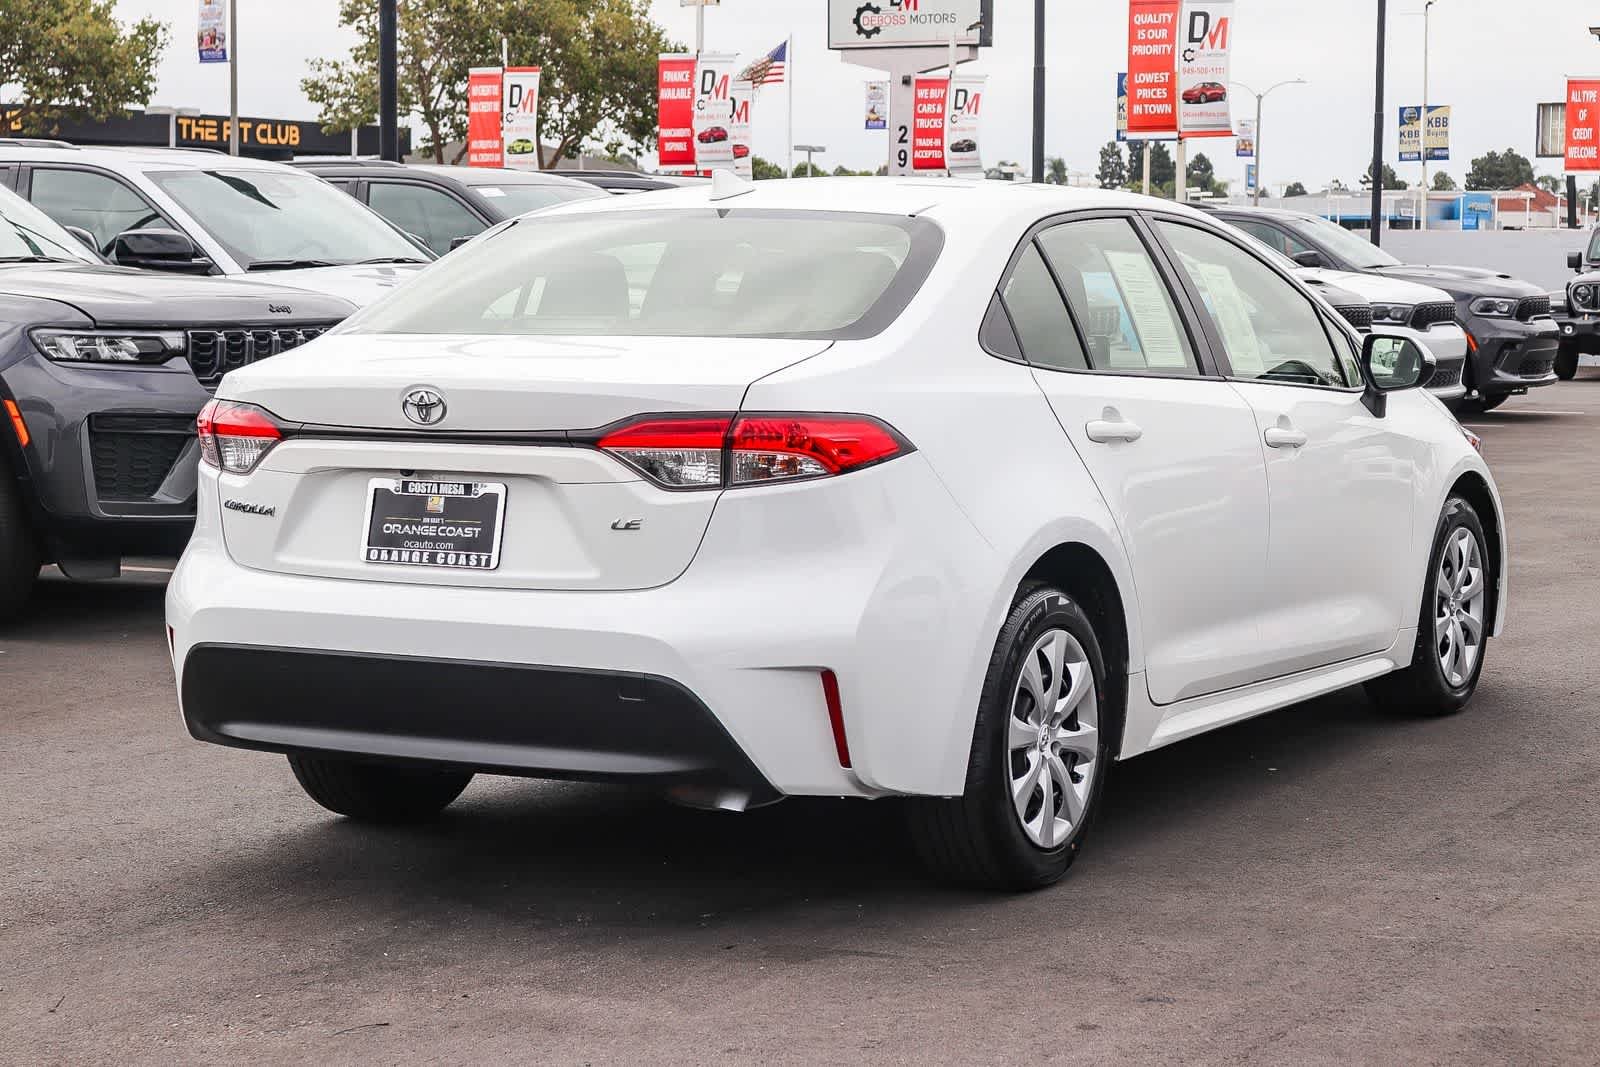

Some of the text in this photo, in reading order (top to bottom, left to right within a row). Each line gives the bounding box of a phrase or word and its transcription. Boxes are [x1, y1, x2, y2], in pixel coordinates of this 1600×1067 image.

[862, 13, 957, 26] DEBOSS MOTORS
[1133, 13, 1173, 25] QUALITY
[1138, 29, 1168, 39] IS OUR
[1188, 11, 1229, 50] DM
[1132, 44, 1173, 56] PRIORITY
[1134, 73, 1170, 83] LOWEST
[702, 70, 729, 100] DM
[509, 84, 534, 113] DM
[660, 88, 692, 99] AVAILABLE
[917, 89, 945, 98] WE BUY
[1136, 88, 1167, 99] PRICES
[1571, 91, 1597, 102] ALL TYPE
[954, 88, 981, 115] DM
[917, 104, 936, 113] CARS
[1133, 104, 1144, 114] IN
[1144, 104, 1172, 114] TOWN
[1579, 109, 1587, 120] OF
[916, 119, 942, 128] TRUCKS
[1427, 117, 1448, 128] KBB
[178, 118, 299, 145] THE FT CLUB
[1573, 128, 1593, 139] CREDIT
[1568, 147, 1597, 158] WELCOME
[408, 482, 464, 495] COSTA MESA
[224, 500, 275, 517] COROLLA
[611, 519, 643, 530] LE
[403, 539, 454, 550] ocauto.com
[370, 549, 488, 567] ORANGE COAST
